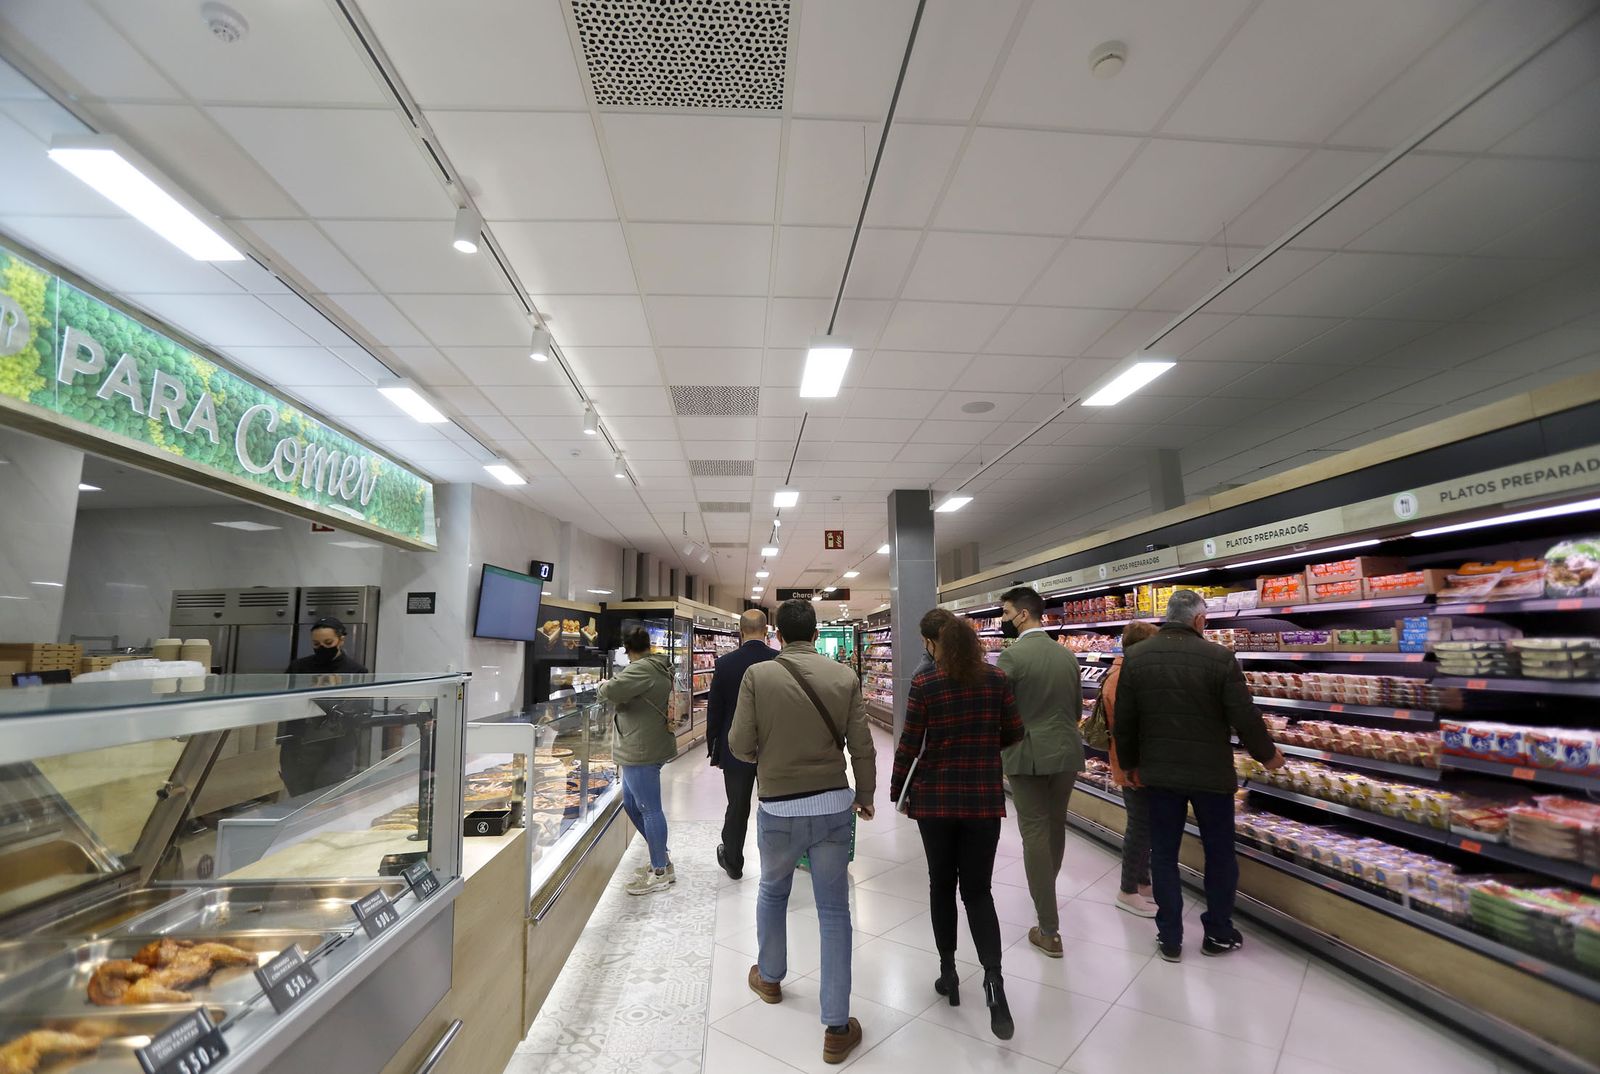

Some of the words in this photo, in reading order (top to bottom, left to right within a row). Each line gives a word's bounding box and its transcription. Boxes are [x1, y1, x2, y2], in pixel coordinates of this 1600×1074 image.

[57, 326, 220, 444] PARA
[235, 404, 379, 507] Comer
[1439, 481, 1497, 503] PLATOS
[1226, 534, 1253, 549] PLATOS
[1254, 522, 1310, 543] PREPARADOS
[540, 565, 549, 578] 0
